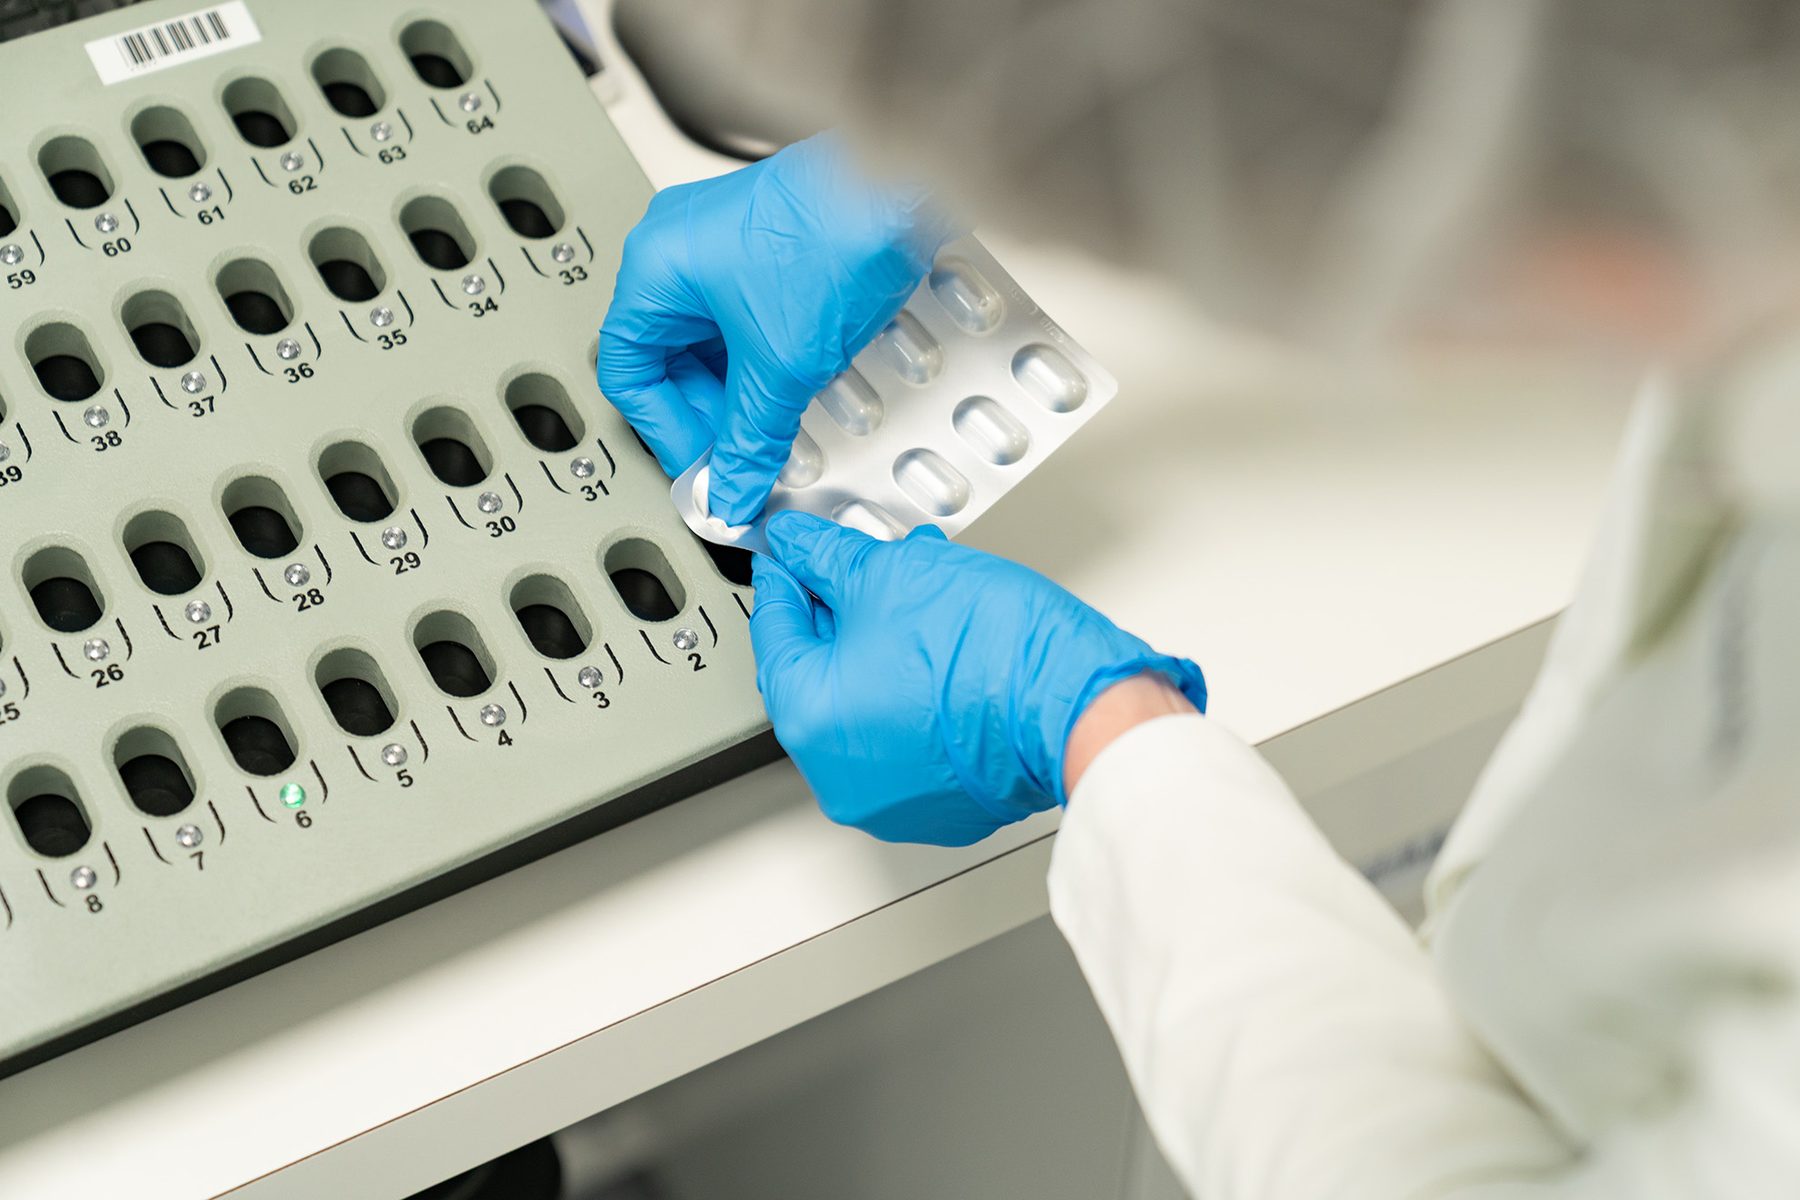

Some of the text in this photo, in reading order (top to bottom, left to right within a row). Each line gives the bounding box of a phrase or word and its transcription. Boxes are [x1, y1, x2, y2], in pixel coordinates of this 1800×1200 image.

[466, 116, 495, 133] 64
[378, 146, 407, 163] 63
[288, 176, 318, 194] 62
[197, 206, 225, 224] 61
[102, 238, 132, 256] 60
[6, 270, 36, 289] 59
[558, 266, 588, 285] 33
[468, 297, 499, 317] 34
[377, 329, 408, 349] 35
[283, 363, 315, 383] 36
[188, 396, 215, 417] 37
[90, 431, 123, 451] 38
[580, 480, 610, 501] 31
[485, 516, 517, 537] 30
[389, 552, 421, 574] 29
[292, 589, 325, 612] 28
[192, 625, 221, 650] 27
[687, 653, 707, 671] 2
[90, 664, 124, 688] 26
[592, 692, 611, 708] 3
[498, 730, 513, 745] 4
[396, 769, 414, 787] 5
[295, 811, 313, 828] 6
[189, 851, 204, 870] 7
[85, 895, 104, 913] 8
